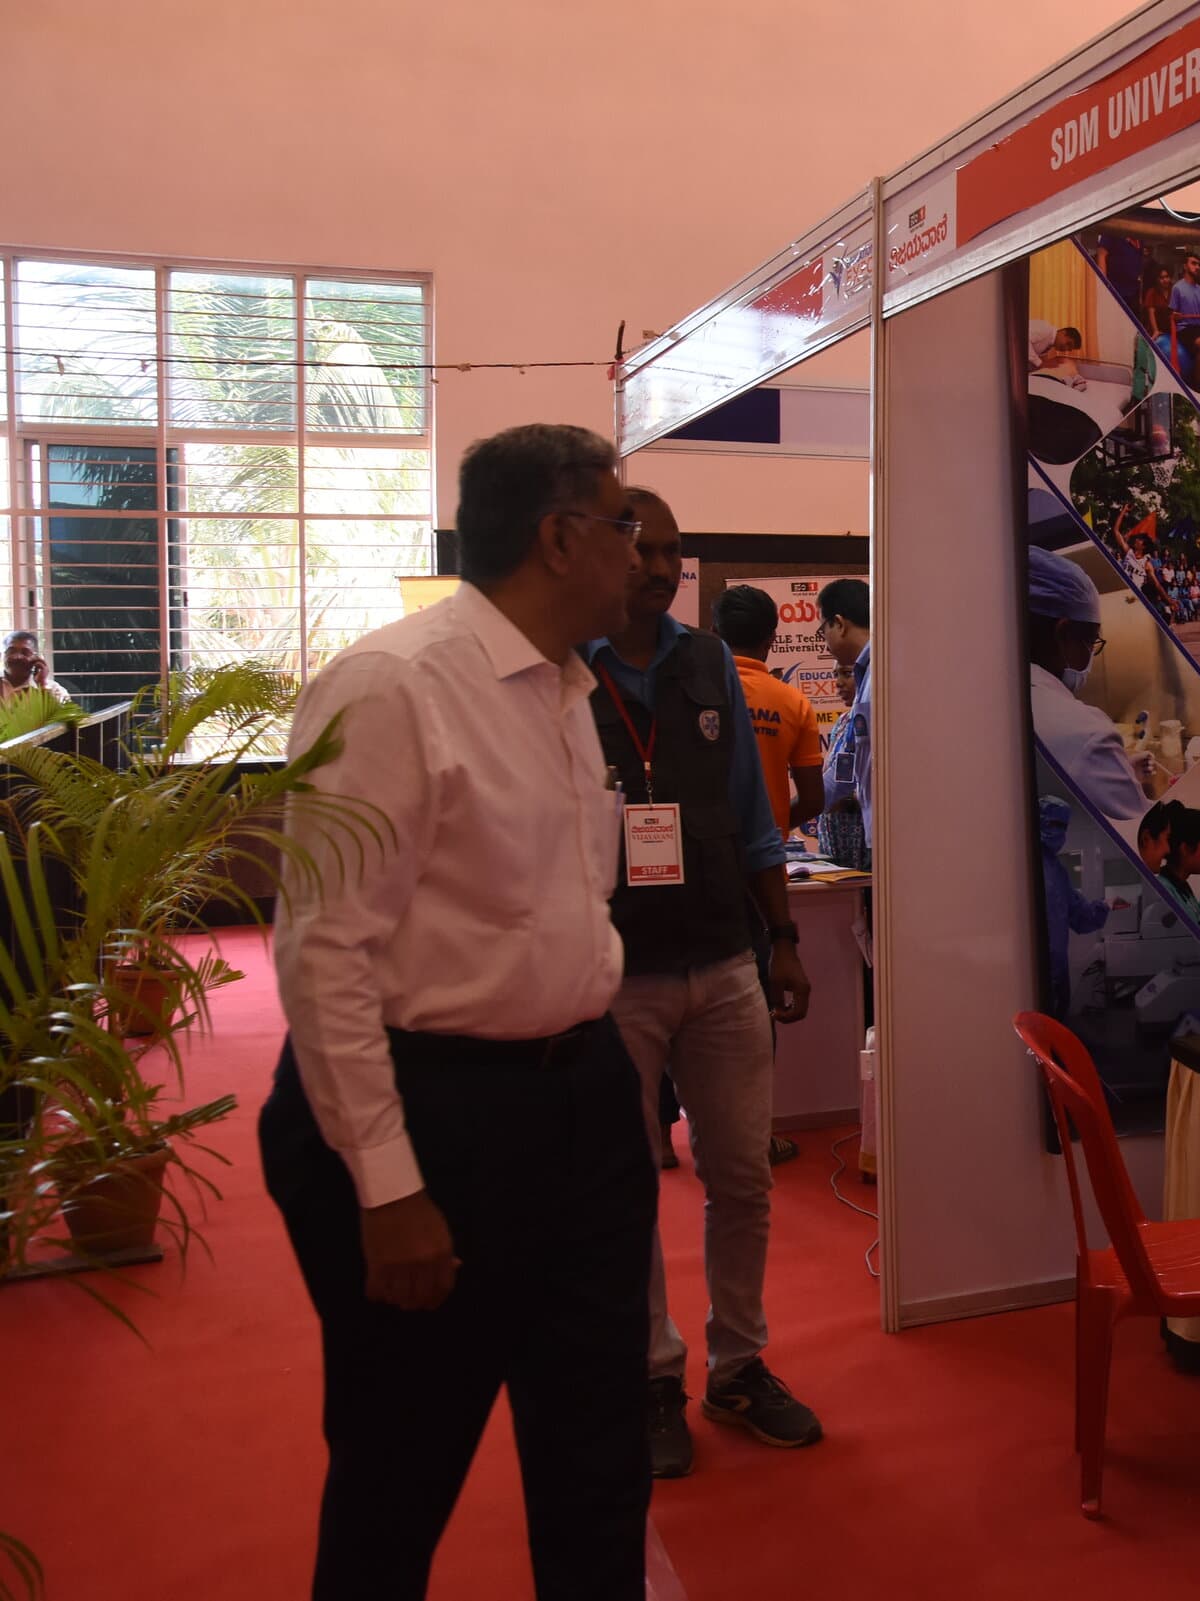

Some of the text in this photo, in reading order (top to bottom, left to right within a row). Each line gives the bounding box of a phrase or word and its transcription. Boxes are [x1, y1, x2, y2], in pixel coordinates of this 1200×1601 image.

[1050, 105, 1099, 171] SDM
[771, 644, 826, 654] University
[641, 867, 668, 875] STAFF
